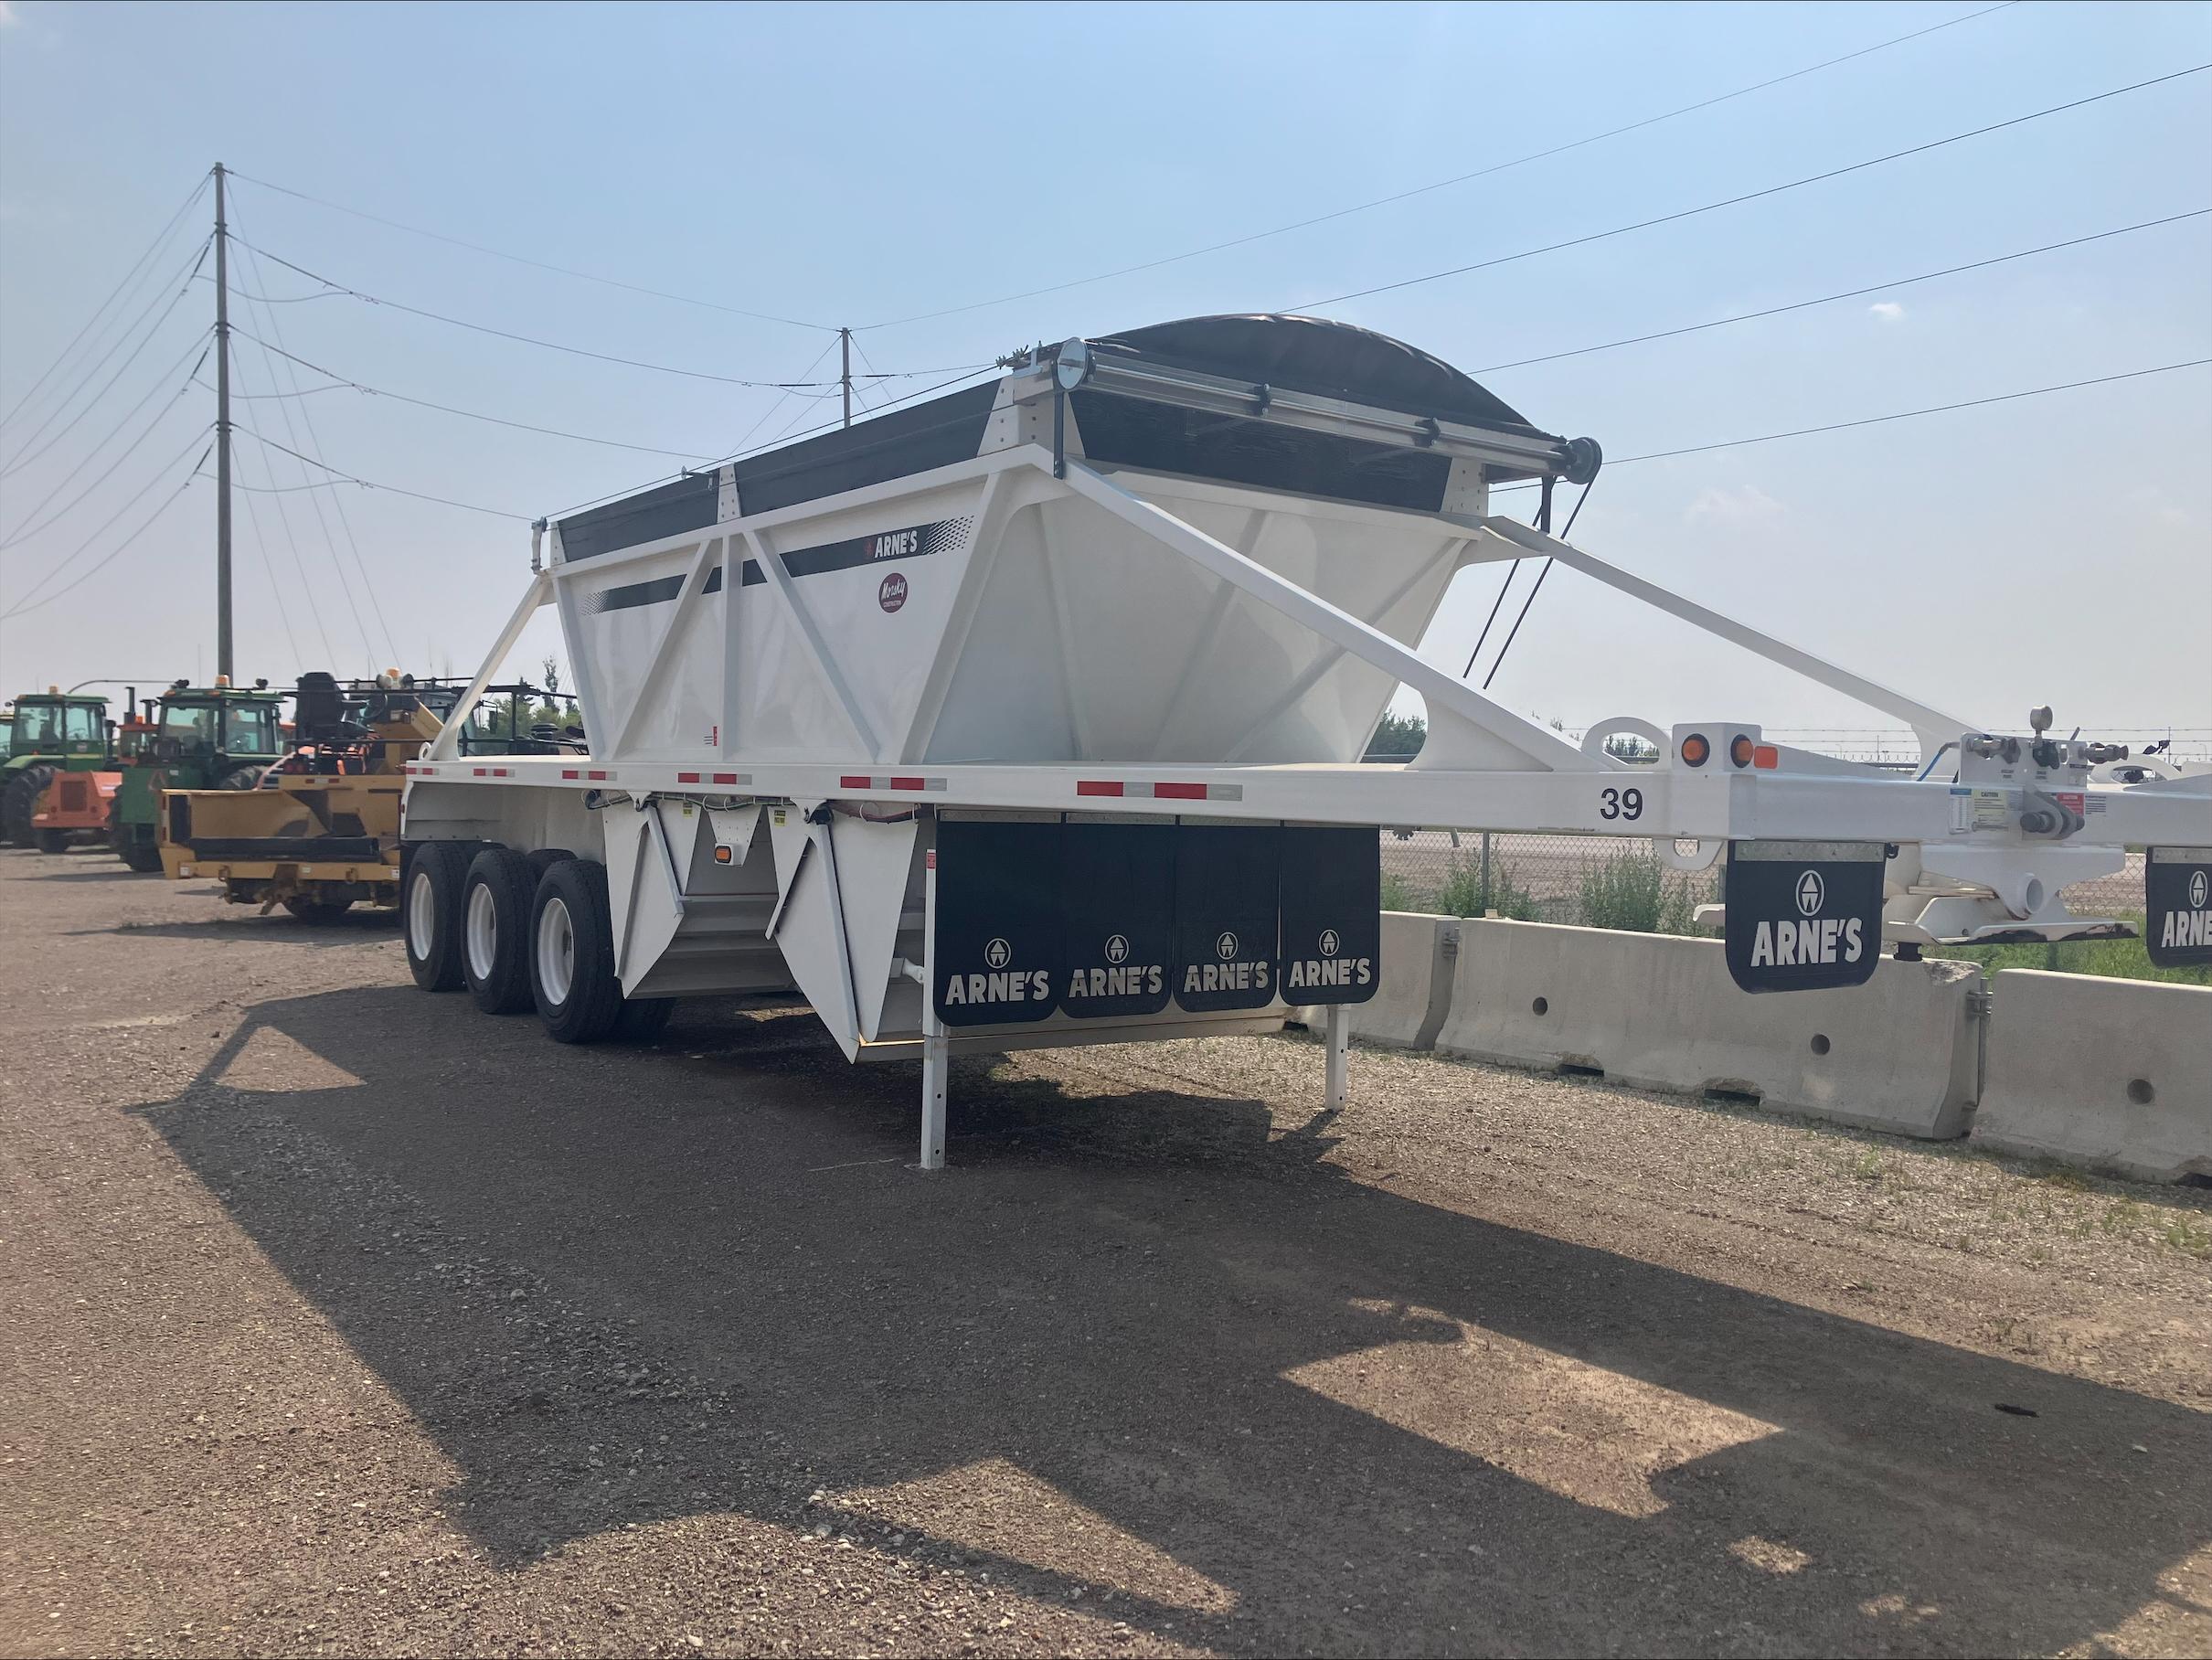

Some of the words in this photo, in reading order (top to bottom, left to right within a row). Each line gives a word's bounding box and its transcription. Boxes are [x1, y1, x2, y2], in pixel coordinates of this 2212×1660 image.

[875, 530, 918, 559] ARNE'S
[1601, 789, 1643, 820] 39
[1749, 917, 1863, 967] ARNE'S
[945, 969, 1049, 1006] ARNE'S
[1069, 964, 1163, 998] ARNE'S
[1183, 960, 1269, 993] ARNE'S
[1288, 957, 1371, 988] ARNE'S
